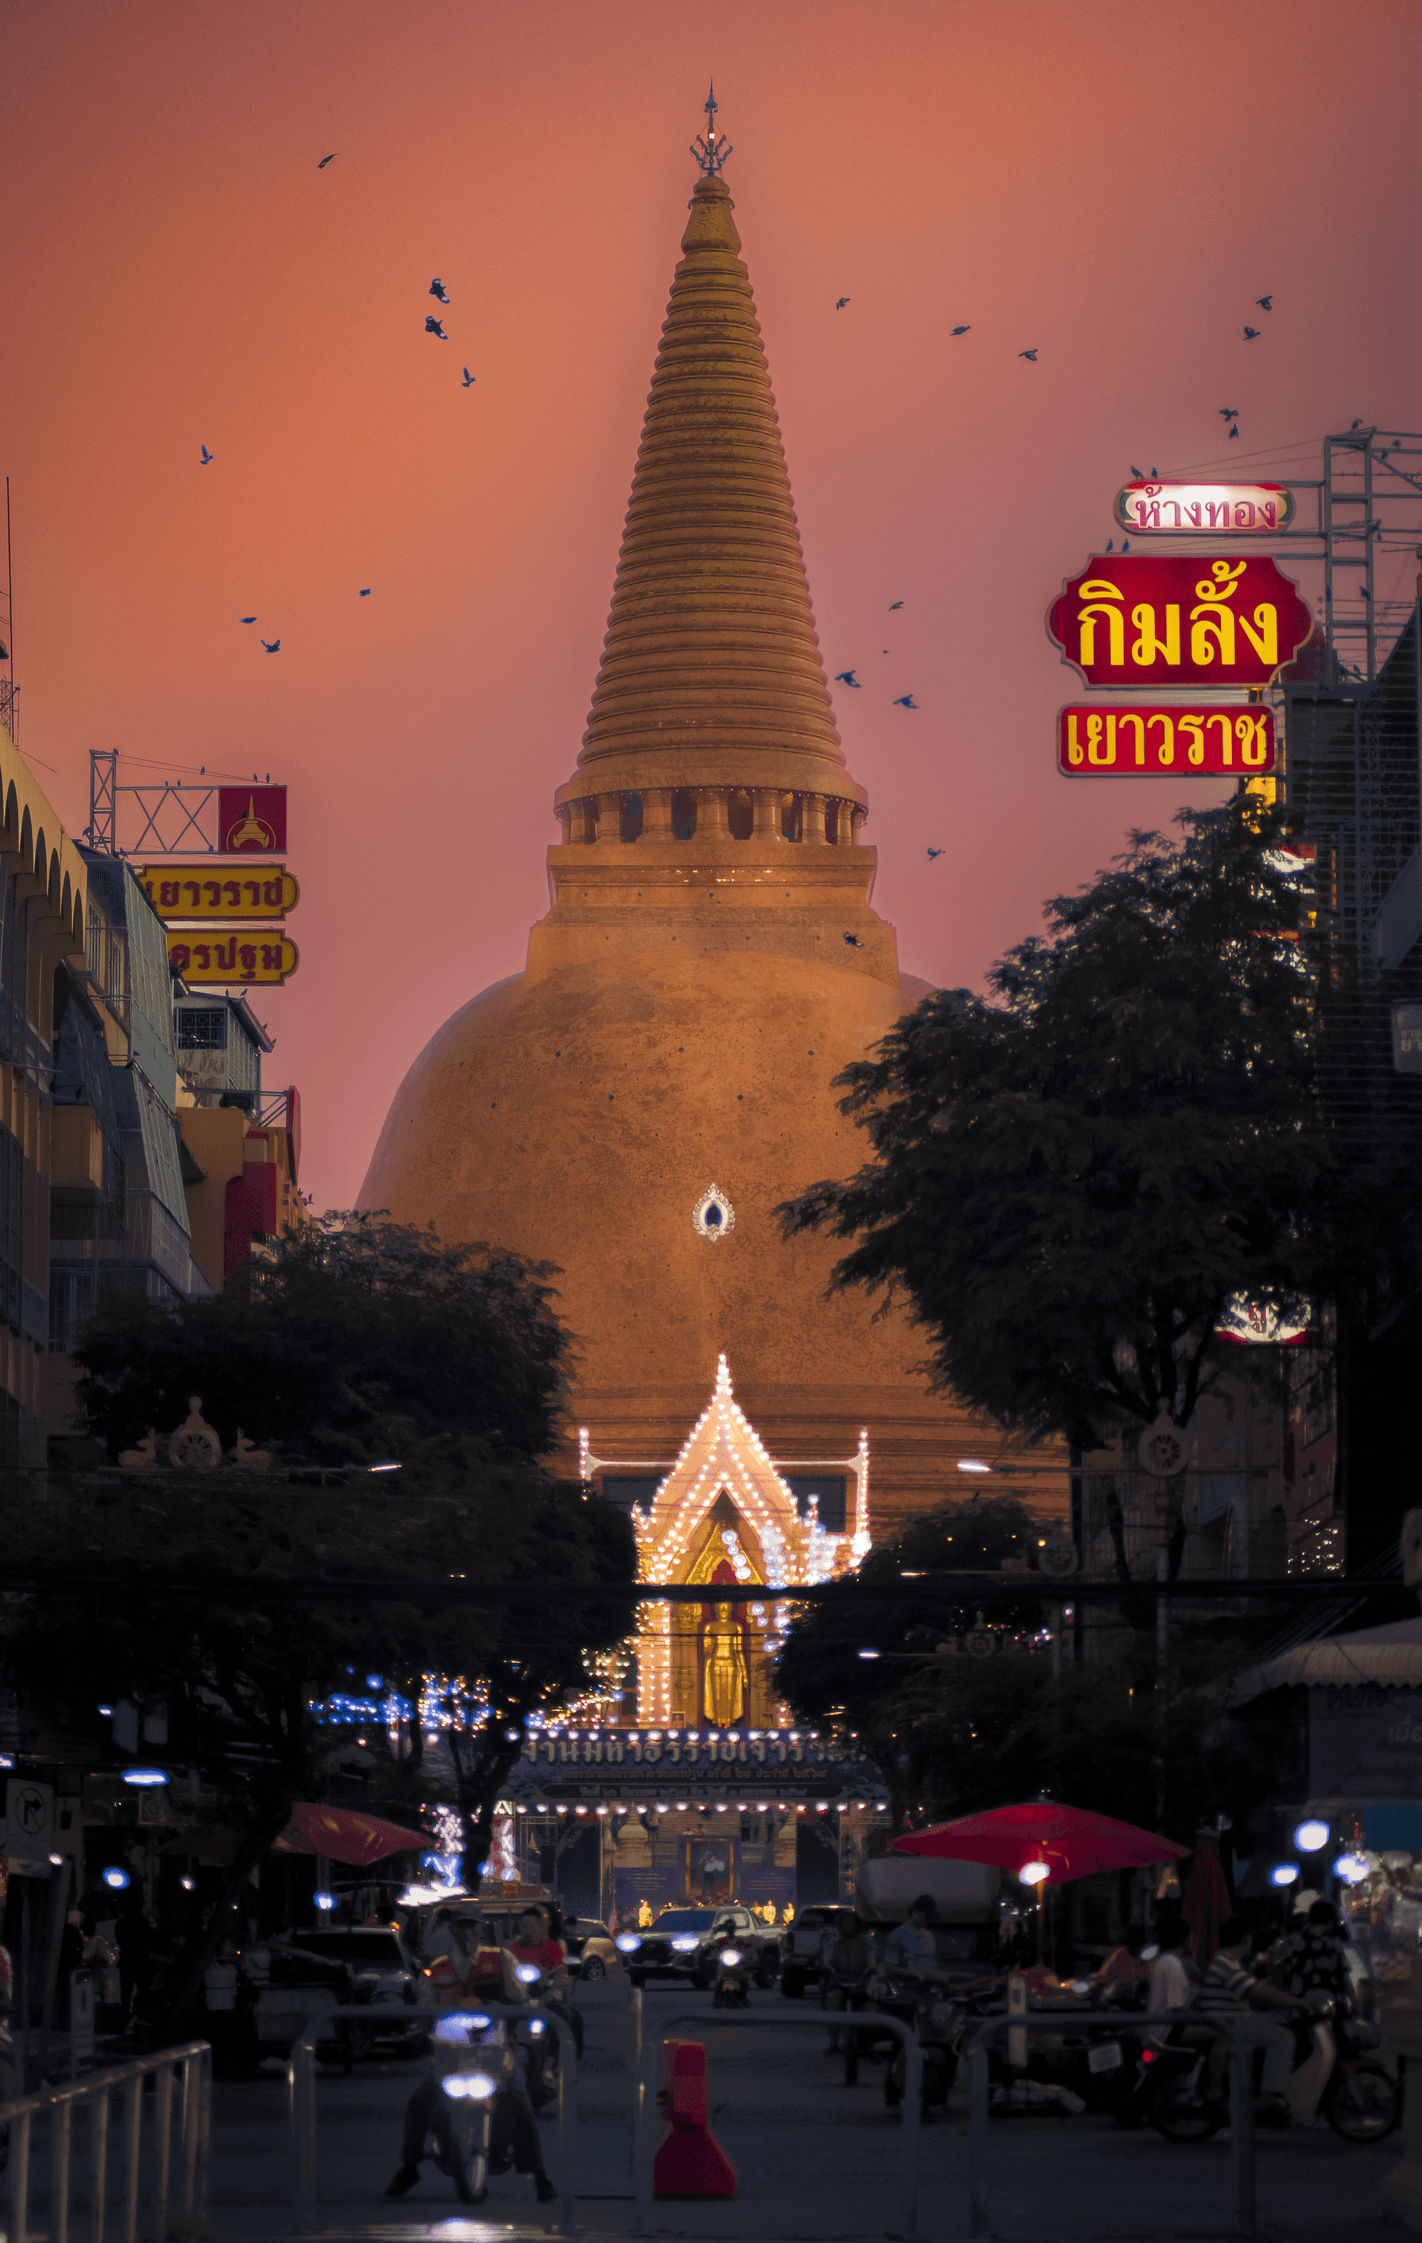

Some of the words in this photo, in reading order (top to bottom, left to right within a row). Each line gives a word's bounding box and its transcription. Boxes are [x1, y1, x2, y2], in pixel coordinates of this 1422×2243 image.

[1135, 486, 1278, 528] ห้างทอง
[1077, 560, 1278, 665] กิมลั้ง
[1067, 714, 1267, 765] เยาวราช
[145, 877, 283, 907] เยาวราช
